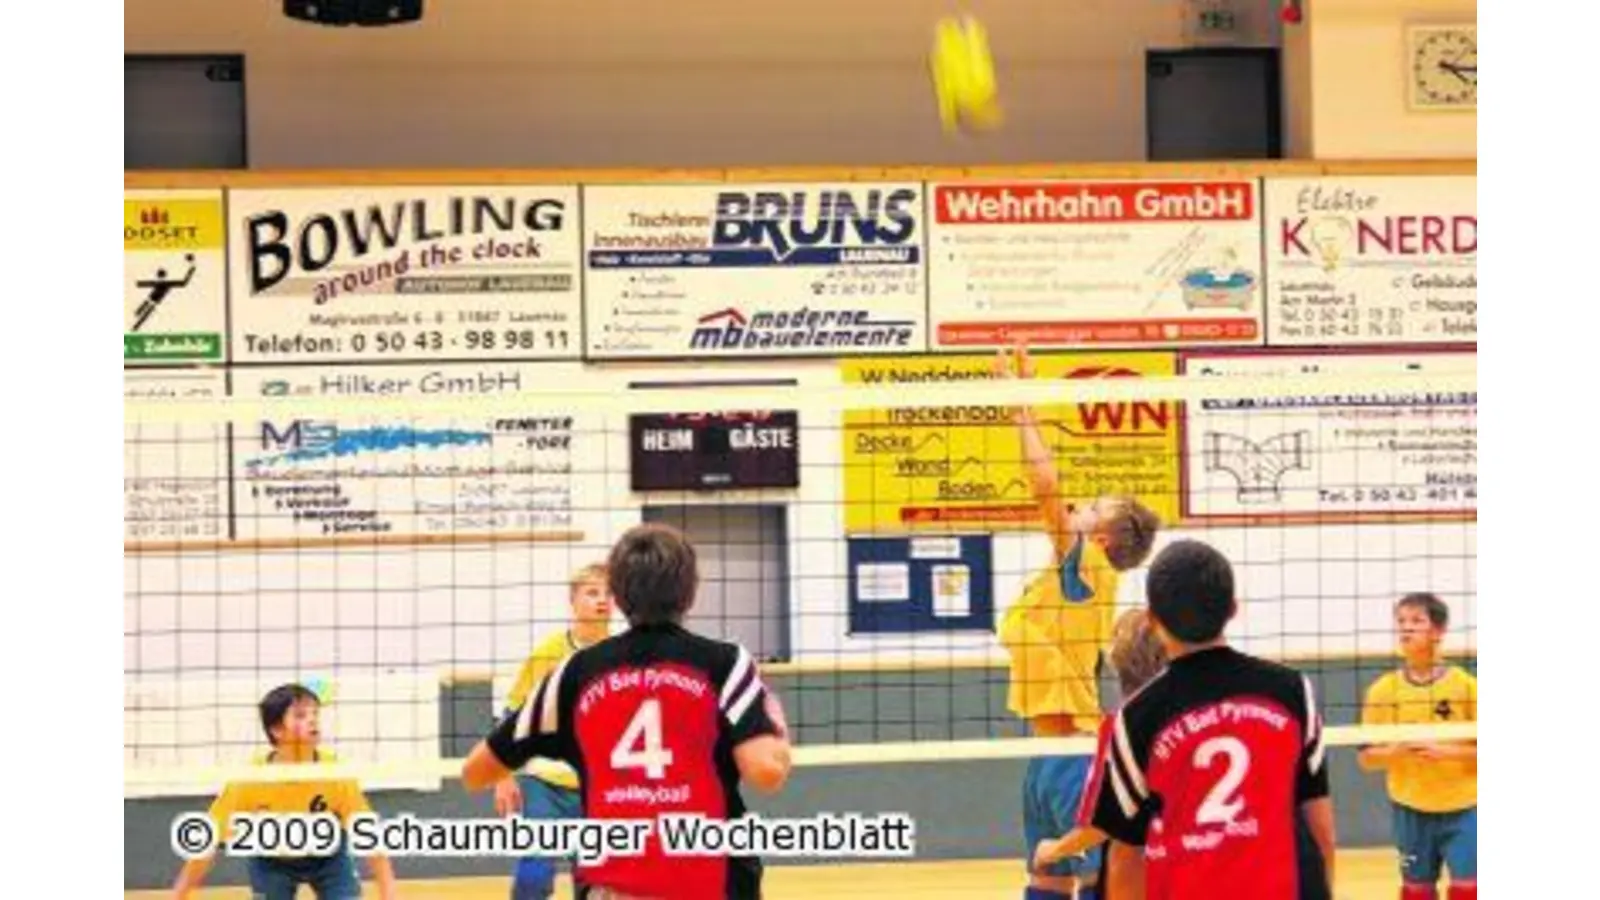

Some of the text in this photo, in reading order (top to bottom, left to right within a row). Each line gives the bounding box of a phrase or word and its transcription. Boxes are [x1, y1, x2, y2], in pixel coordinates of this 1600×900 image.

[946, 187, 1243, 220] Wehrhahn GmbH
[713, 189, 917, 256] BRUNS
[247, 197, 565, 295] BOWLING
[313, 237, 541, 304] around the clock
[752, 307, 869, 328] moderne
[245, 332, 341, 353] Telefon:
[351, 333, 365, 353] 0
[375, 332, 406, 352] 50
[414, 331, 443, 351] 43
[465, 330, 497, 350] 98
[504, 330, 534, 350] 98
[545, 330, 569, 348] 11
[689, 321, 747, 349] mb
[745, 328, 912, 348] bauelemente
[320, 375, 410, 394] Hilker
[419, 372, 522, 393] GmbH
[643, 422, 793, 451] HEIM GÄSTE
[610, 699, 674, 780] 4
[1192, 736, 1250, 827] 2
